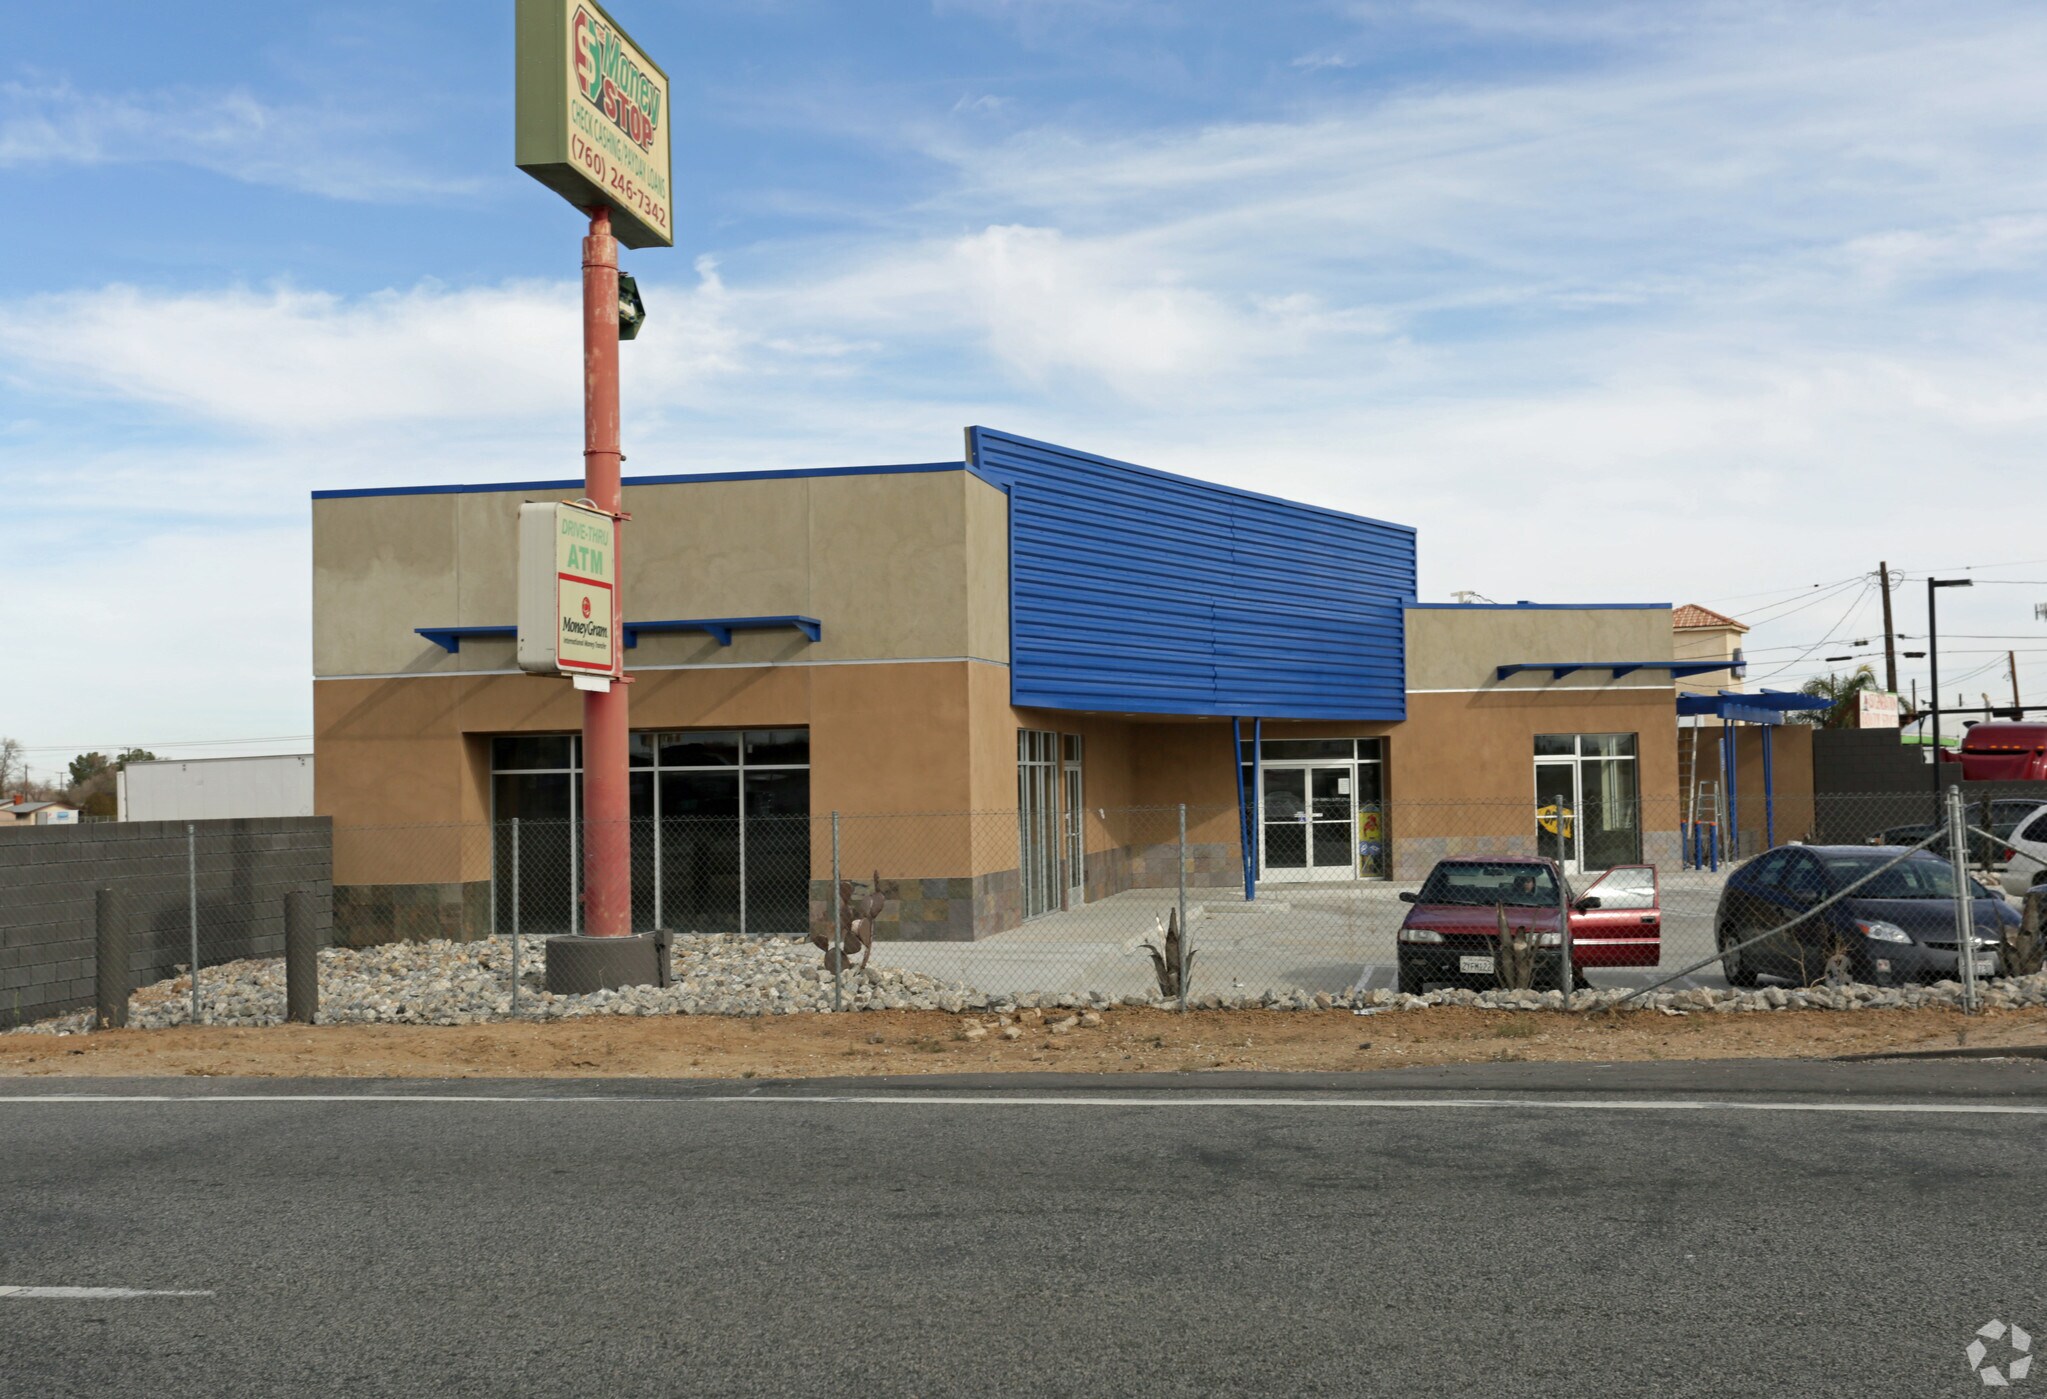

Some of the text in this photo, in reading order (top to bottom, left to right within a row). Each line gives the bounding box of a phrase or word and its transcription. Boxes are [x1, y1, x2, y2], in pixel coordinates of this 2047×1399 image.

[602, 28, 660, 125] Money
[604, 79, 653, 148] STOP
[572, 99, 593, 138] CHECK
[647, 164, 665, 199] LOANS
[572, 133, 666, 228] (760) 246-7342
[561, 518, 609, 546] DRIVE-THRU
[567, 544, 603, 576] ATM
[562, 616, 608, 638] MoneyGram
